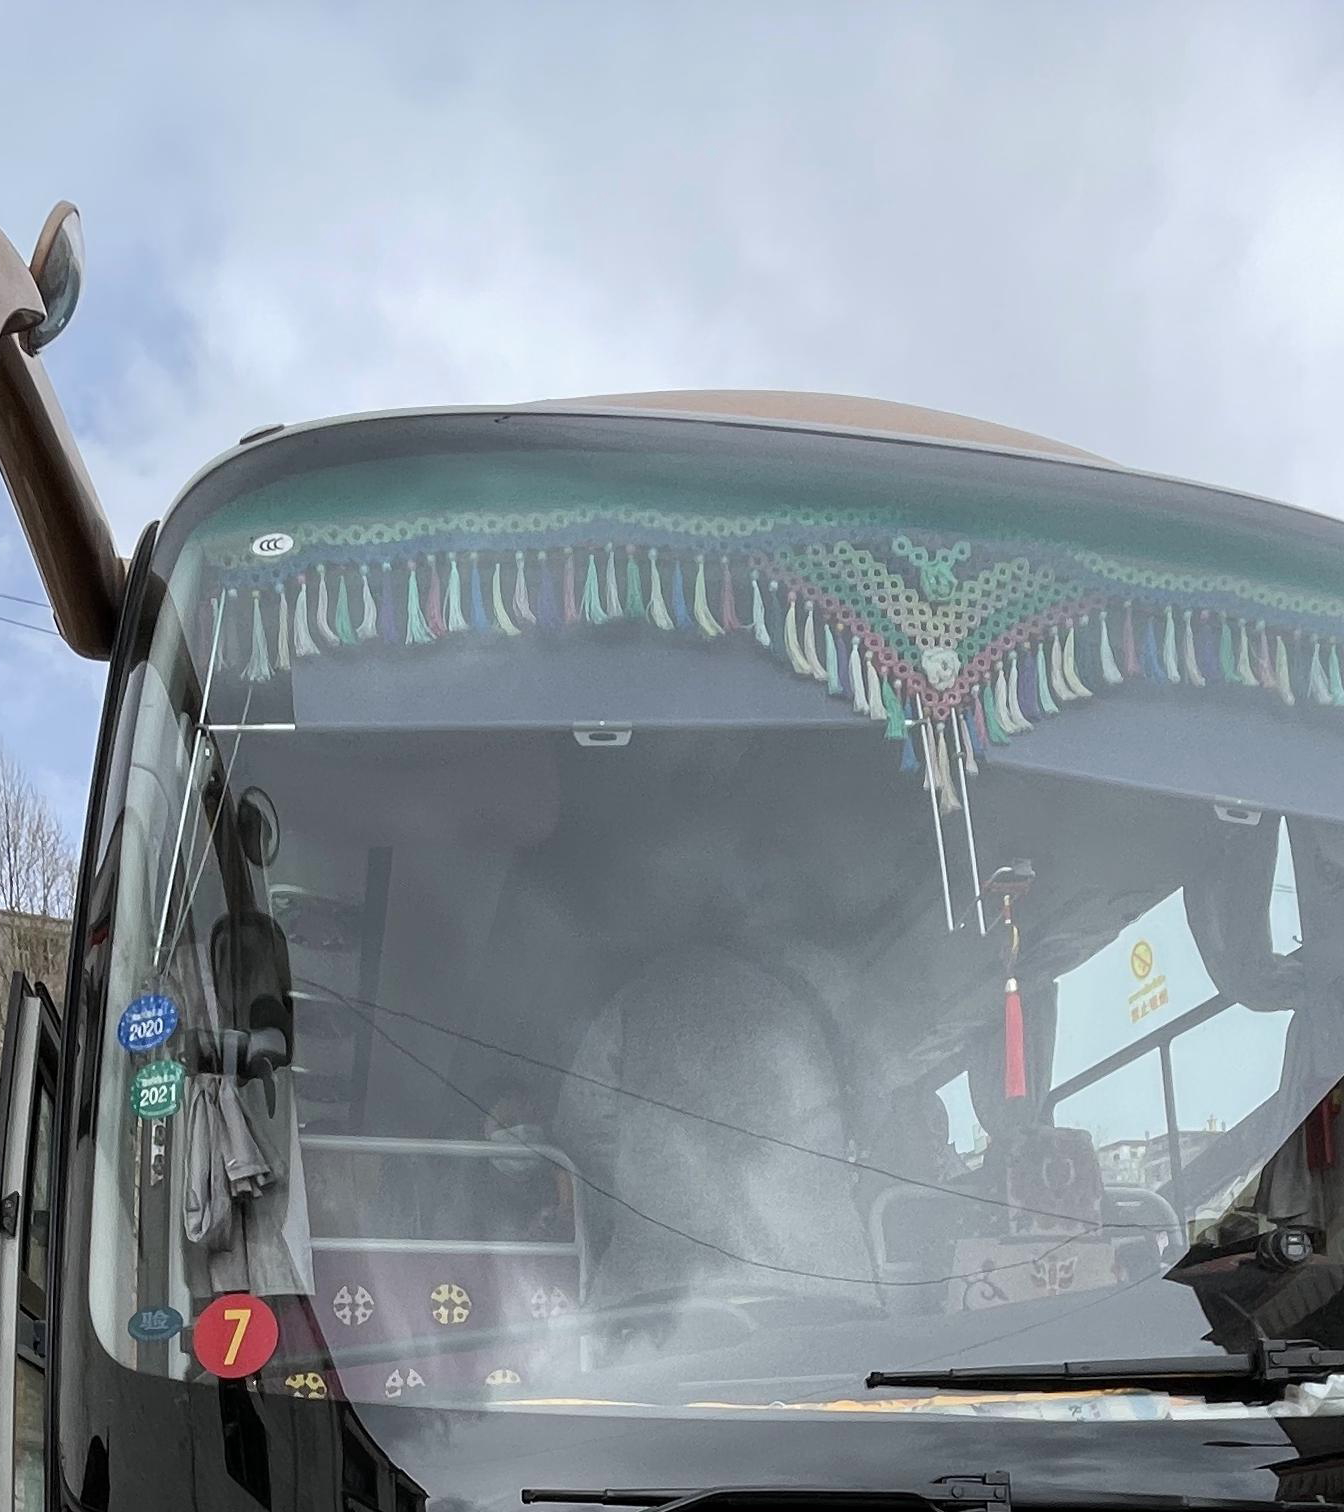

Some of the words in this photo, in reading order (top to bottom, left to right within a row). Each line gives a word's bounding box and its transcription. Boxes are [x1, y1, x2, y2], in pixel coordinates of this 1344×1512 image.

[129, 1018, 163, 1042] 2020
[140, 1083, 176, 1107] 2021
[139, 1309, 170, 1331] 验
[223, 1308, 252, 1366] 7
